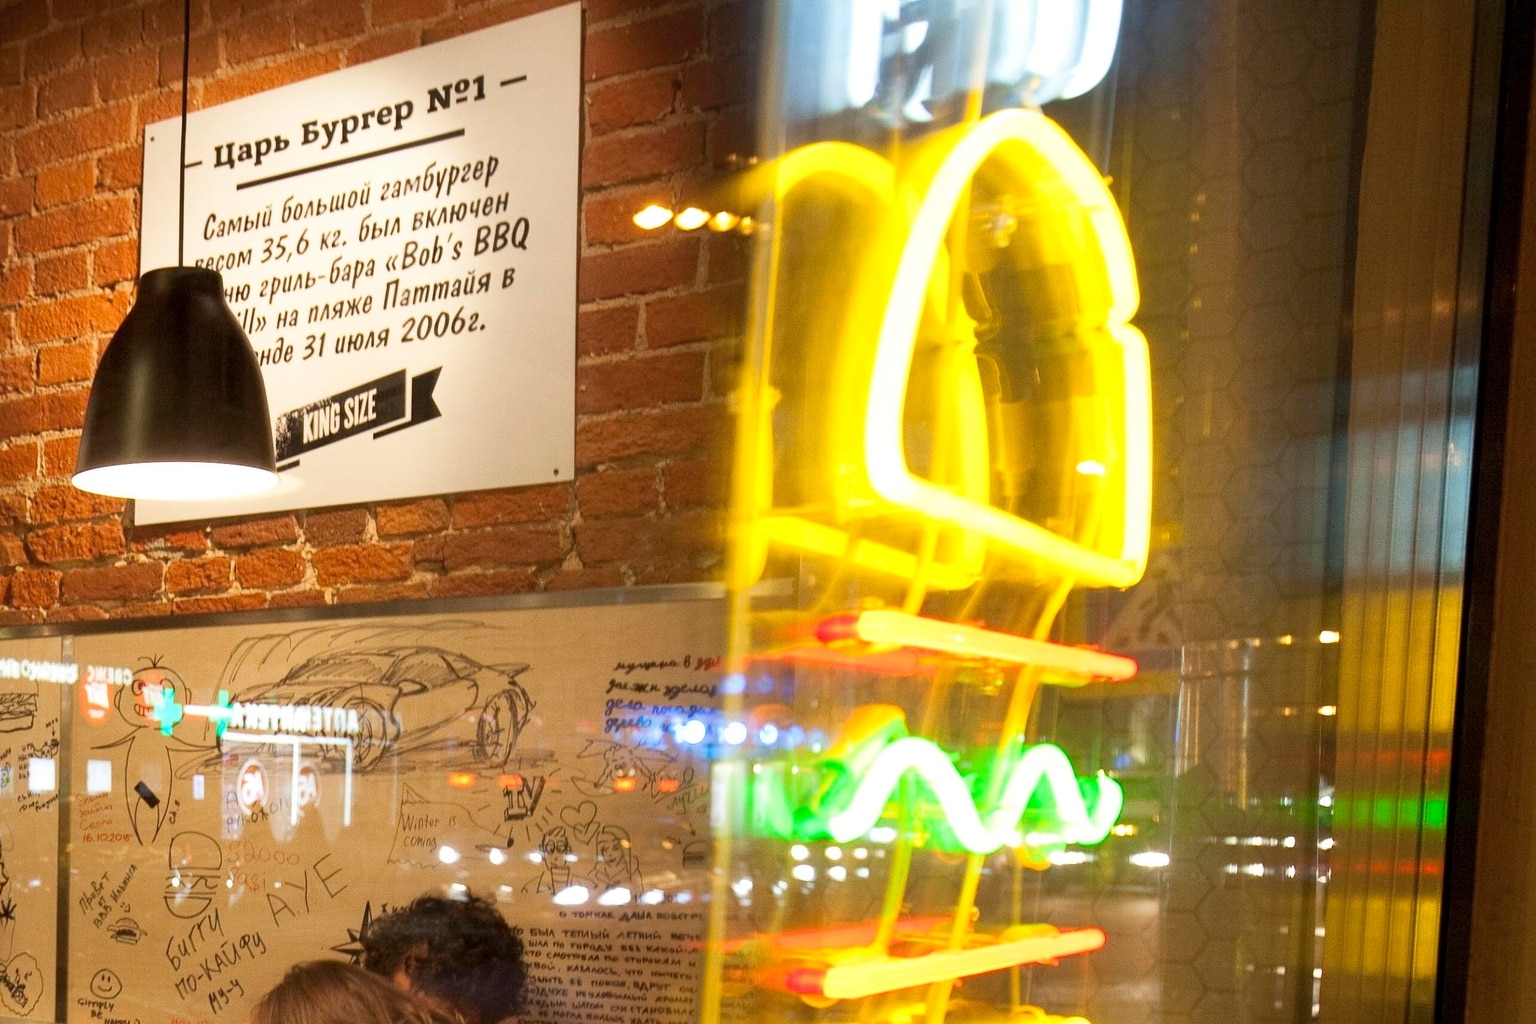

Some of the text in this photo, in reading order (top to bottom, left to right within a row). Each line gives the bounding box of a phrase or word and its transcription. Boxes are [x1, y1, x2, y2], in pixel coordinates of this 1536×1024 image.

[214, 134, 290, 169] Царь
[302, 98, 414, 150] Бургер
[203, 155, 499, 242] Самый большой гамбургер
[261, 234, 310, 264] 35,6
[358, 214, 401, 241] был
[412, 193, 509, 230] включен
[259, 257, 375, 304] гриль-бара
[474, 217, 530, 256] BBQ
[276, 307, 298, 329] на
[308, 295, 373, 323] пляже
[382, 270, 490, 310] Паттайя
[502, 268, 515, 288] в
[303, 333, 326, 361] 31
[335, 328, 389, 354] июля
[401, 308, 486, 343] 2006г.
[302, 389, 378, 445] KING SIZE
[401, 815, 438, 832] Winter
[404, 836, 437, 853] coming
[530, 928, 555, 938] БЫЛ
[562, 928, 610, 939] ТЕПЛЫЙ
